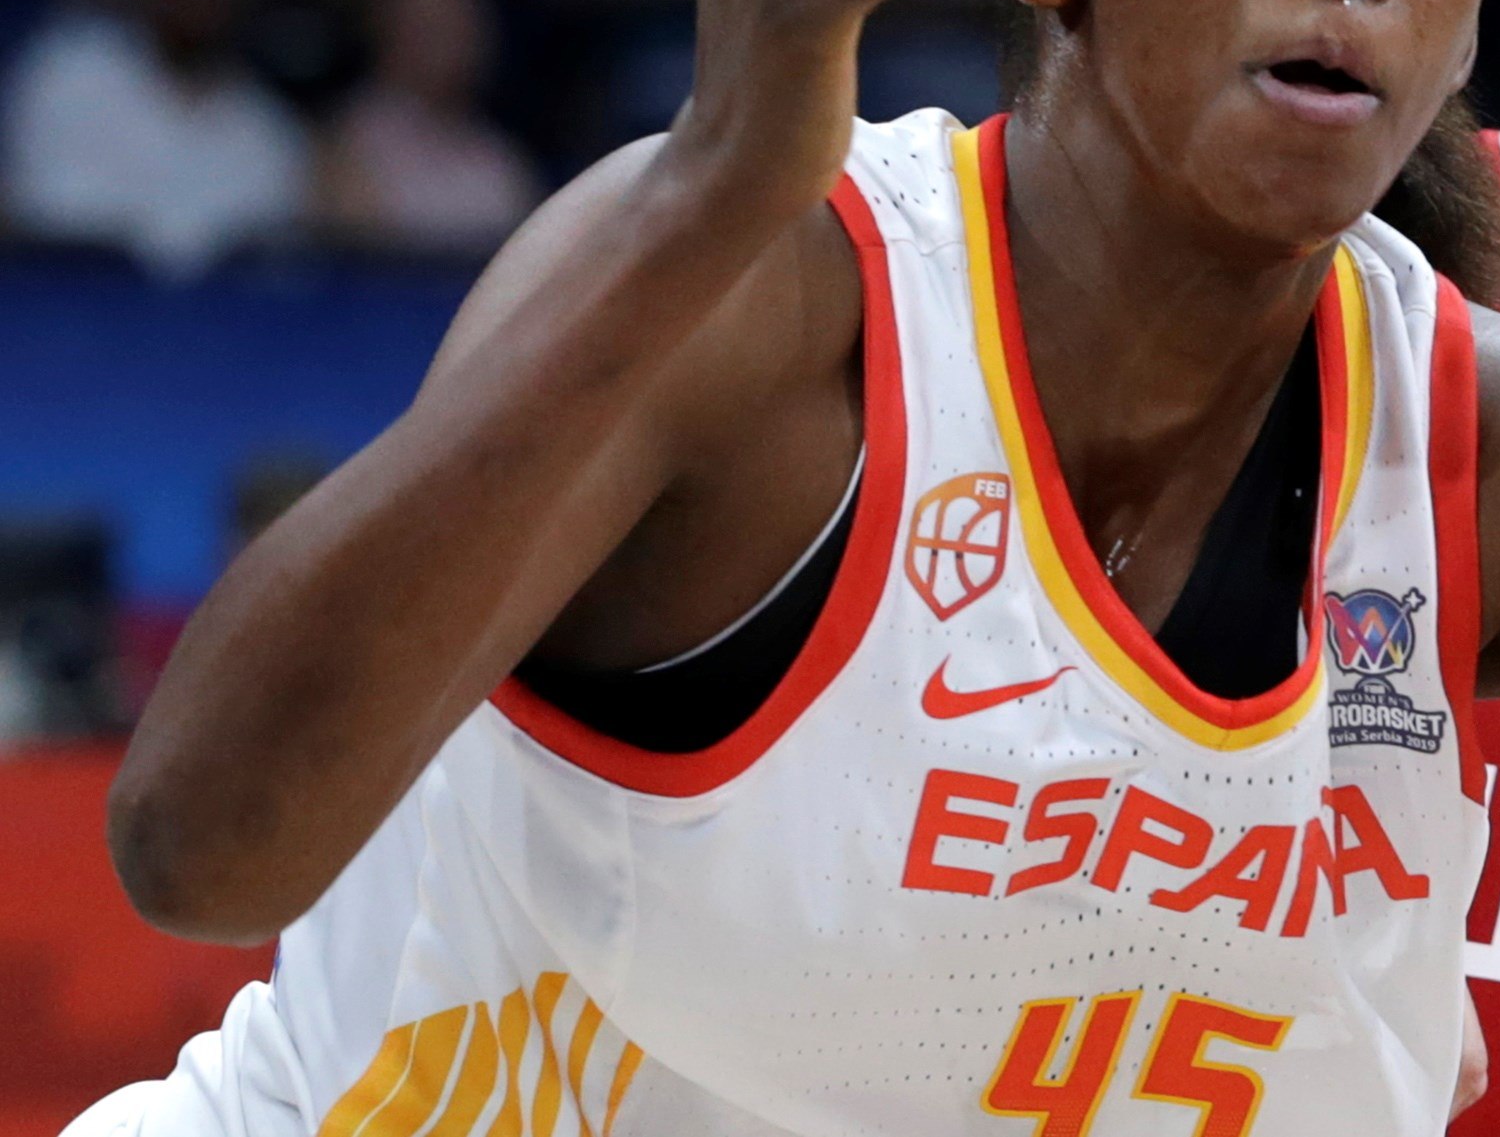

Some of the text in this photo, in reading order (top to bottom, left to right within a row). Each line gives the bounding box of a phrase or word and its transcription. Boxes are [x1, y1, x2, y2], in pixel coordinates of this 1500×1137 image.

[974, 478, 1008, 500] FEB
[1331, 704, 1443, 737] ROBASKET
[1330, 729, 1437, 752] tvia Serbia 2019
[979, 988, 1295, 1137] 45
